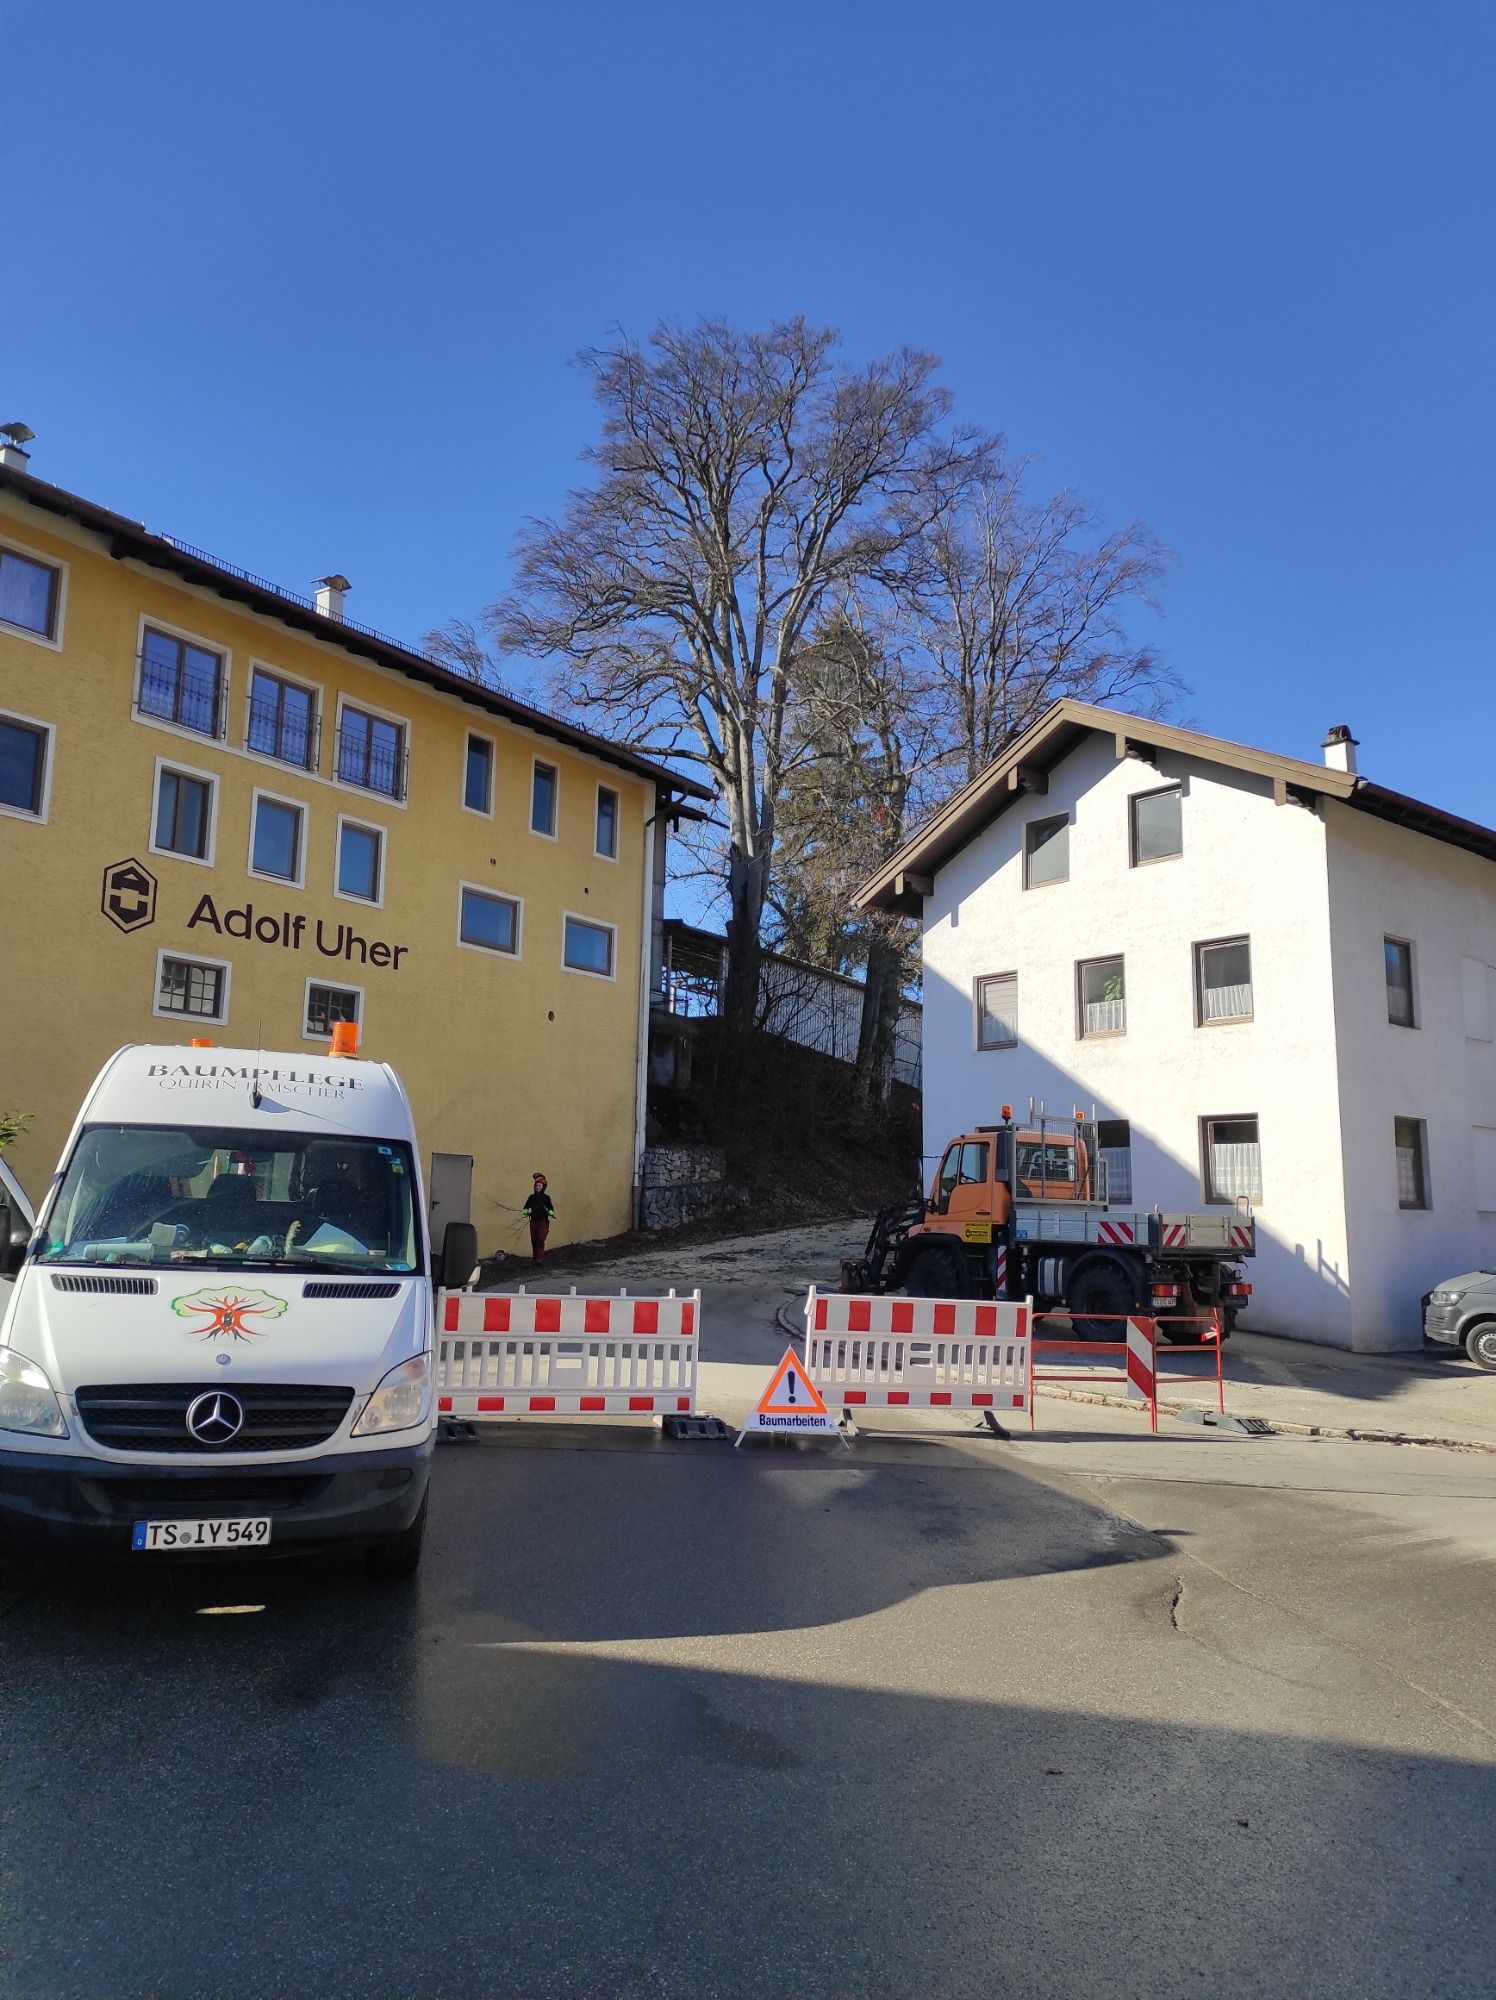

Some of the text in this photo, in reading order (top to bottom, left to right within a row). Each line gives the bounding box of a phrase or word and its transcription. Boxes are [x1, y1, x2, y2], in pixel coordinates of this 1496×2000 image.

[187, 894, 409, 970] Adolf Uher
[148, 1064, 364, 1091] BAUMPFLEGE
[159, 1077, 345, 1100] QUIRIN IRMSCHER
[759, 1414, 826, 1427] Baumarbeiten
[149, 1521, 268, 1546] TS IY 549
